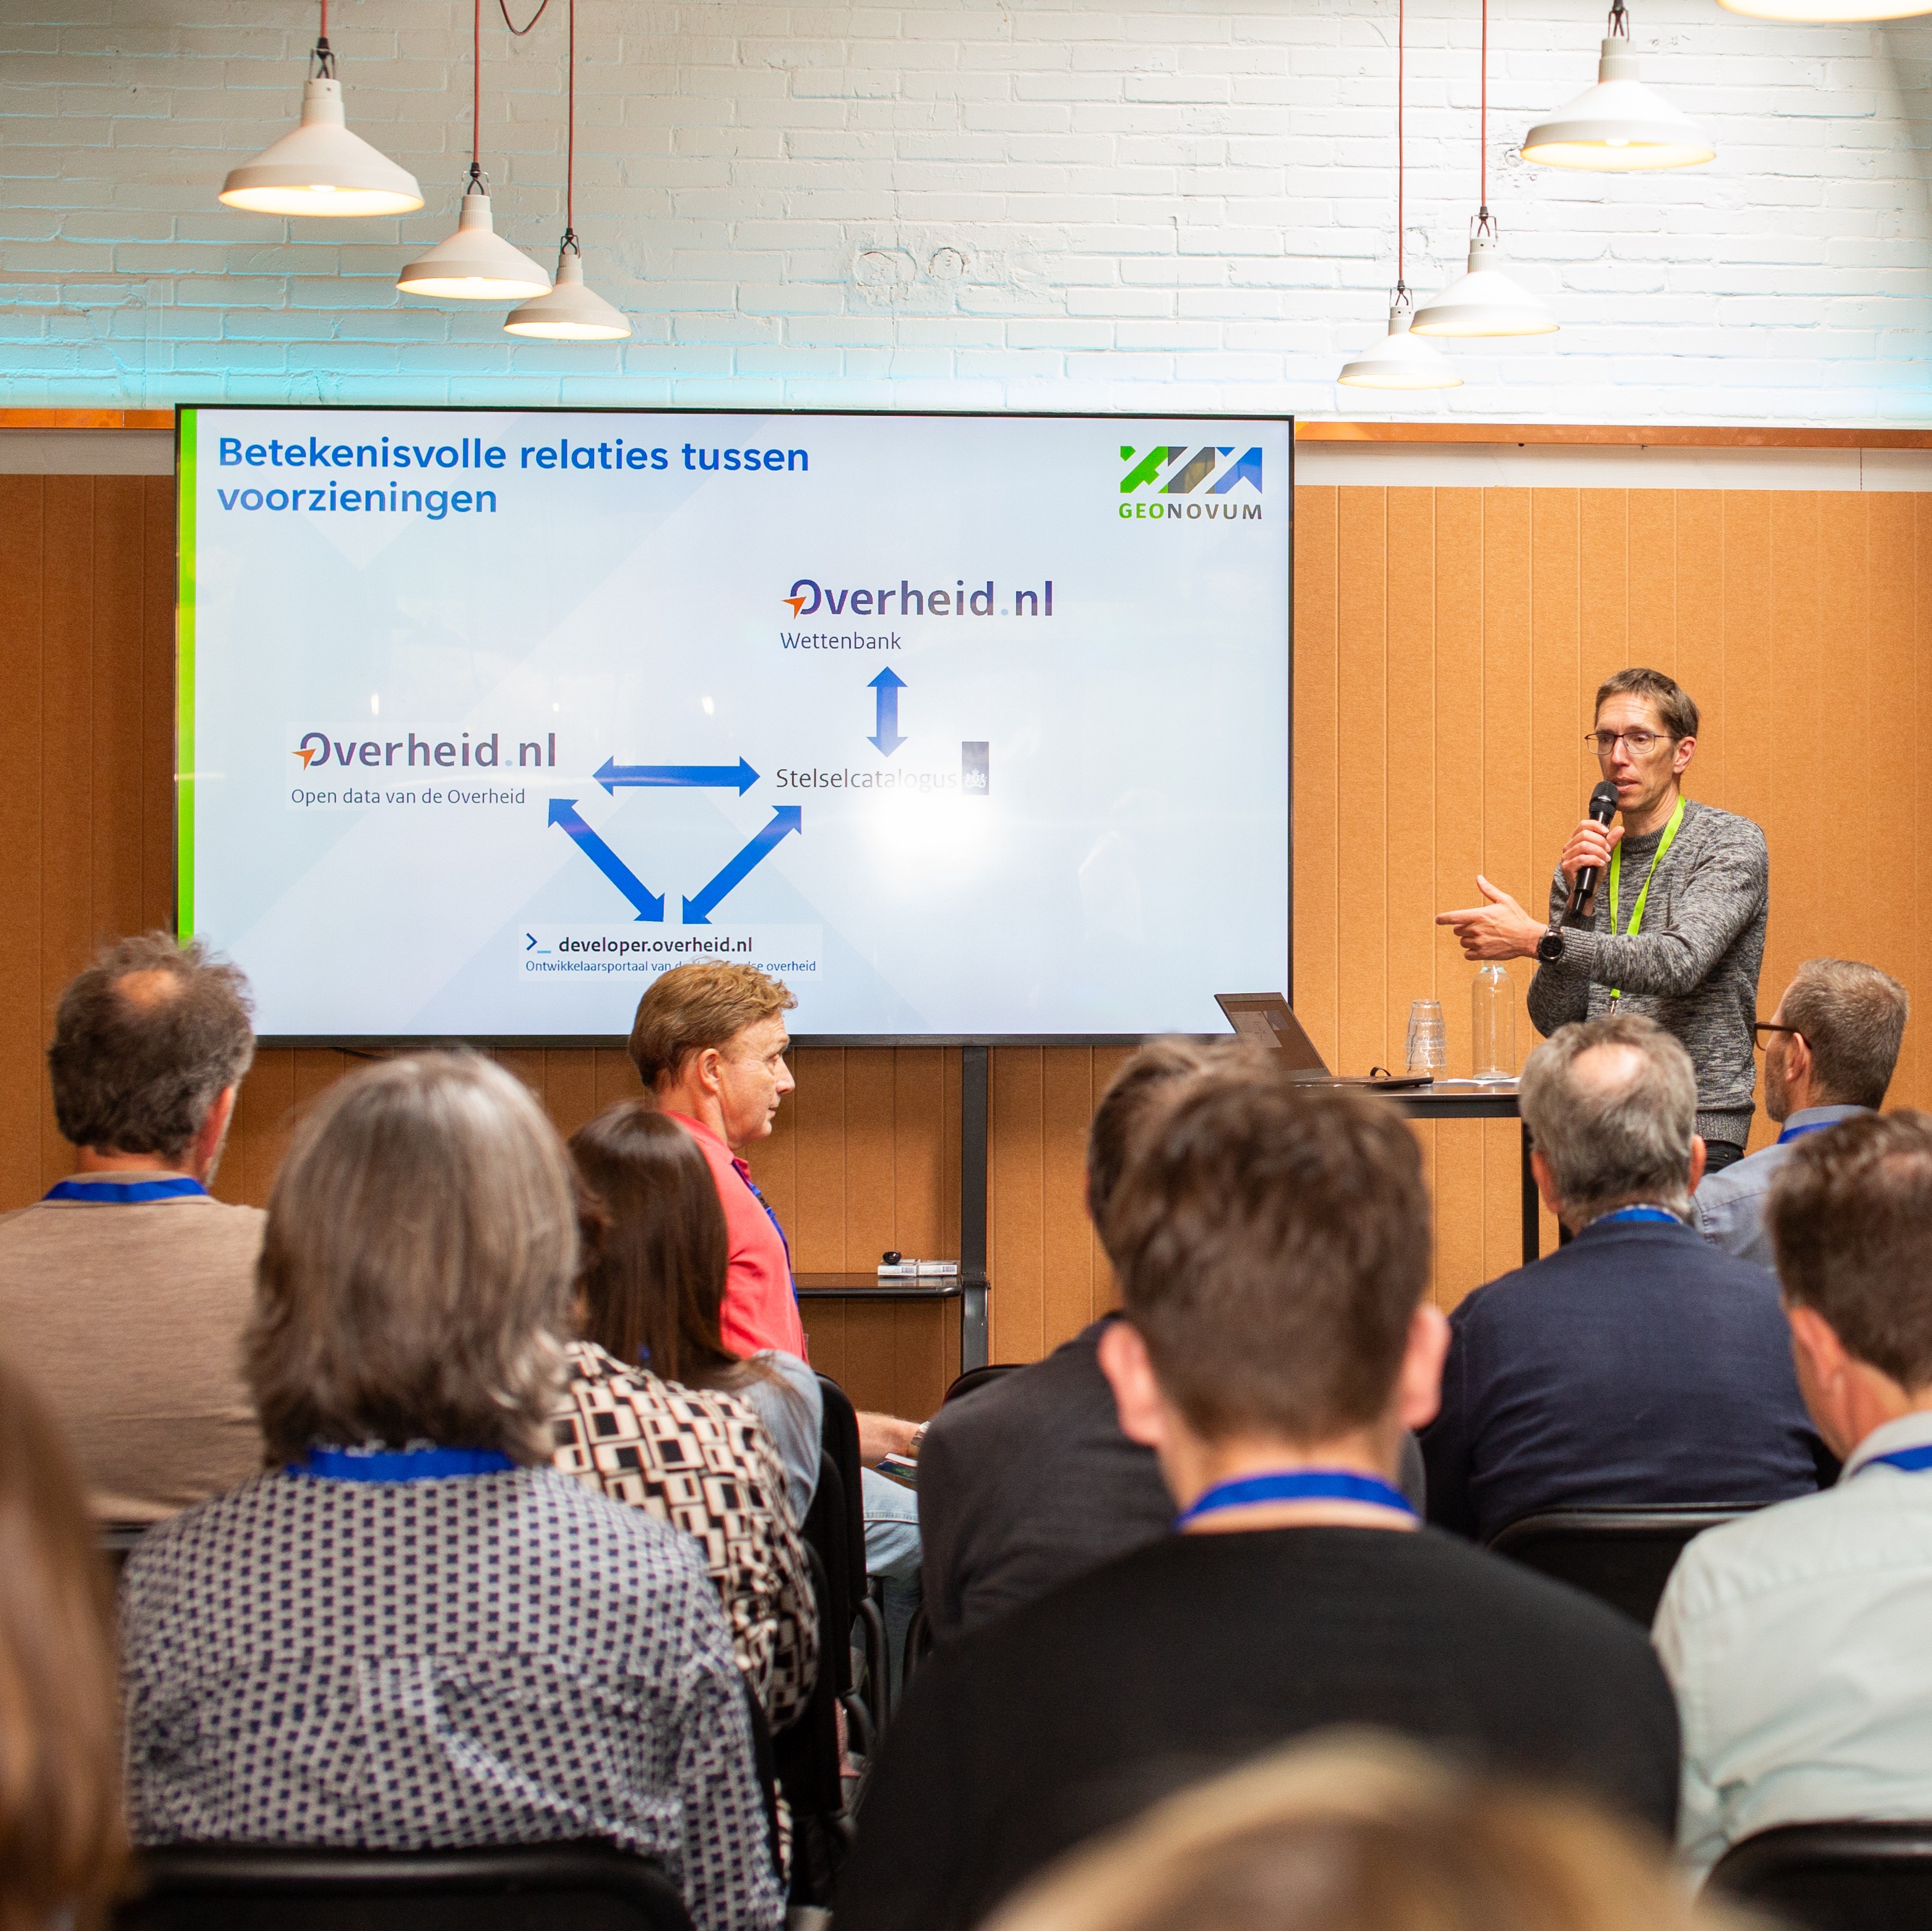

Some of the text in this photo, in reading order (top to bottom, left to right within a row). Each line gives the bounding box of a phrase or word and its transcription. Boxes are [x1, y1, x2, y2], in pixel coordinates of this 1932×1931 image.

[219, 436, 808, 471] Betekenisvolle relaties tussen
[217, 480, 497, 520] voorzieningen
[1118, 502, 1262, 520] GEONOVUM
[788, 578, 1053, 617] Overheid.nl
[780, 631, 902, 650] Wettenbank
[299, 731, 556, 767] Overheid.nl
[775, 768, 957, 793] Stelselcatalogus
[291, 788, 525, 807] Open data van de Overheid
[558, 936, 753, 956] developer.overheid.nl
[525, 960, 648, 974] Ontwikkelaarsportaal
[650, 963, 671, 971] van
[766, 960, 816, 971] overheid
